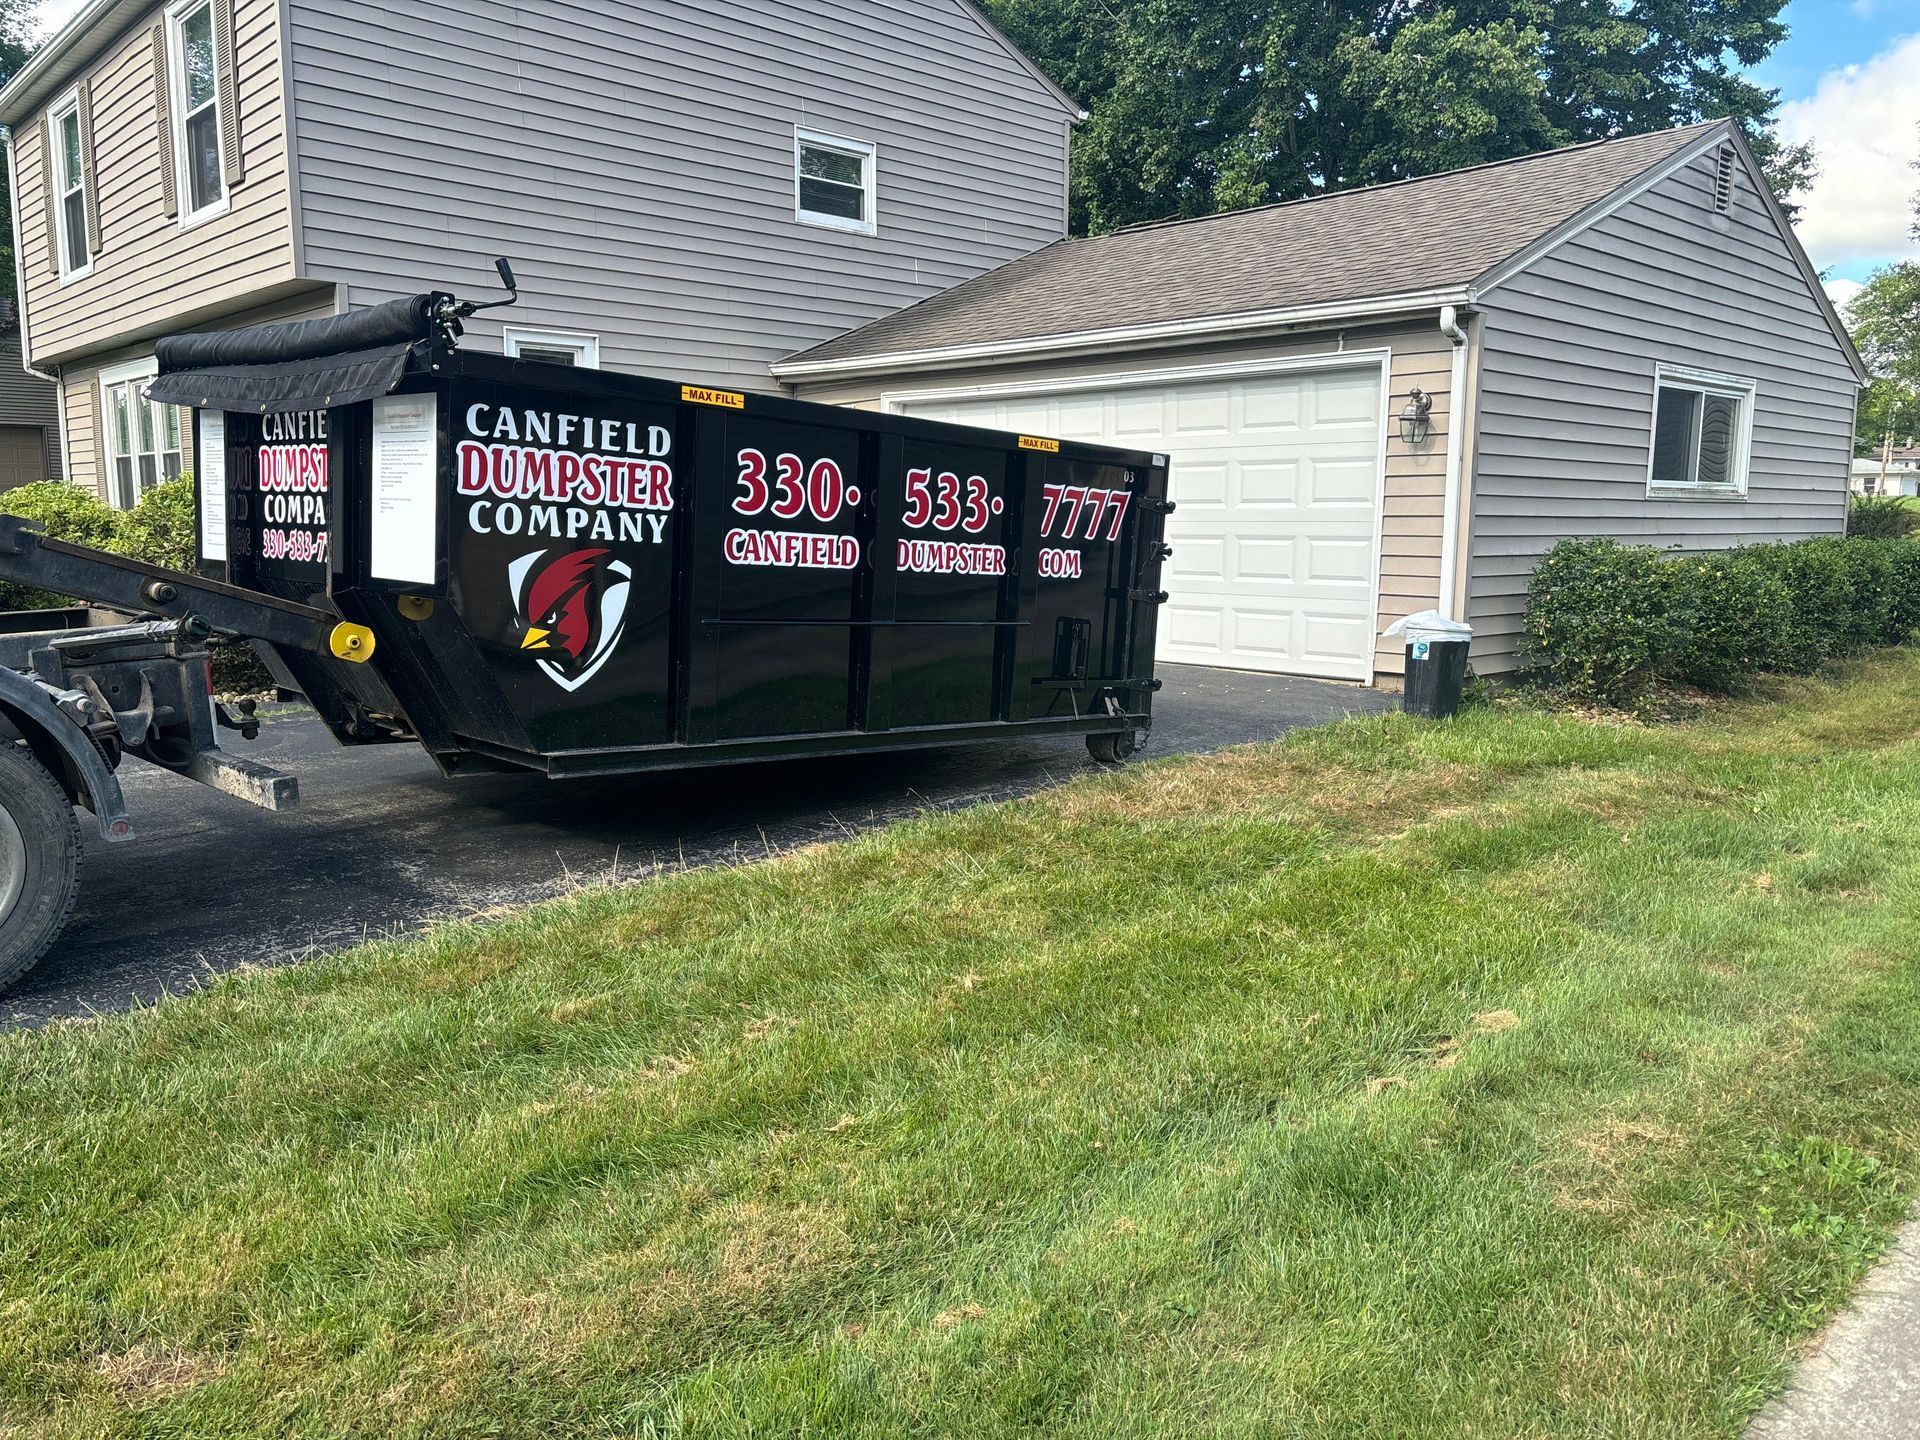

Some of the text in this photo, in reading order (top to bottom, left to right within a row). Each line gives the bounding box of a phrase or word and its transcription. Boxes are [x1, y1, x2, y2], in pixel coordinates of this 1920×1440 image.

[688, 389, 737, 405] MAX FILL
[466, 403, 671, 456] CANFIELD
[1023, 438, 1054, 450] MAX FILL
[456, 440, 674, 511] DUMPSTER
[1123, 470, 1135, 483] 03
[468, 500, 668, 544] COMPANY
[1040, 483, 1132, 541] 7777
[262, 528, 328, 563] 330-533-7
[724, 528, 1082, 579] CANFIELD DUMPSTER COM
